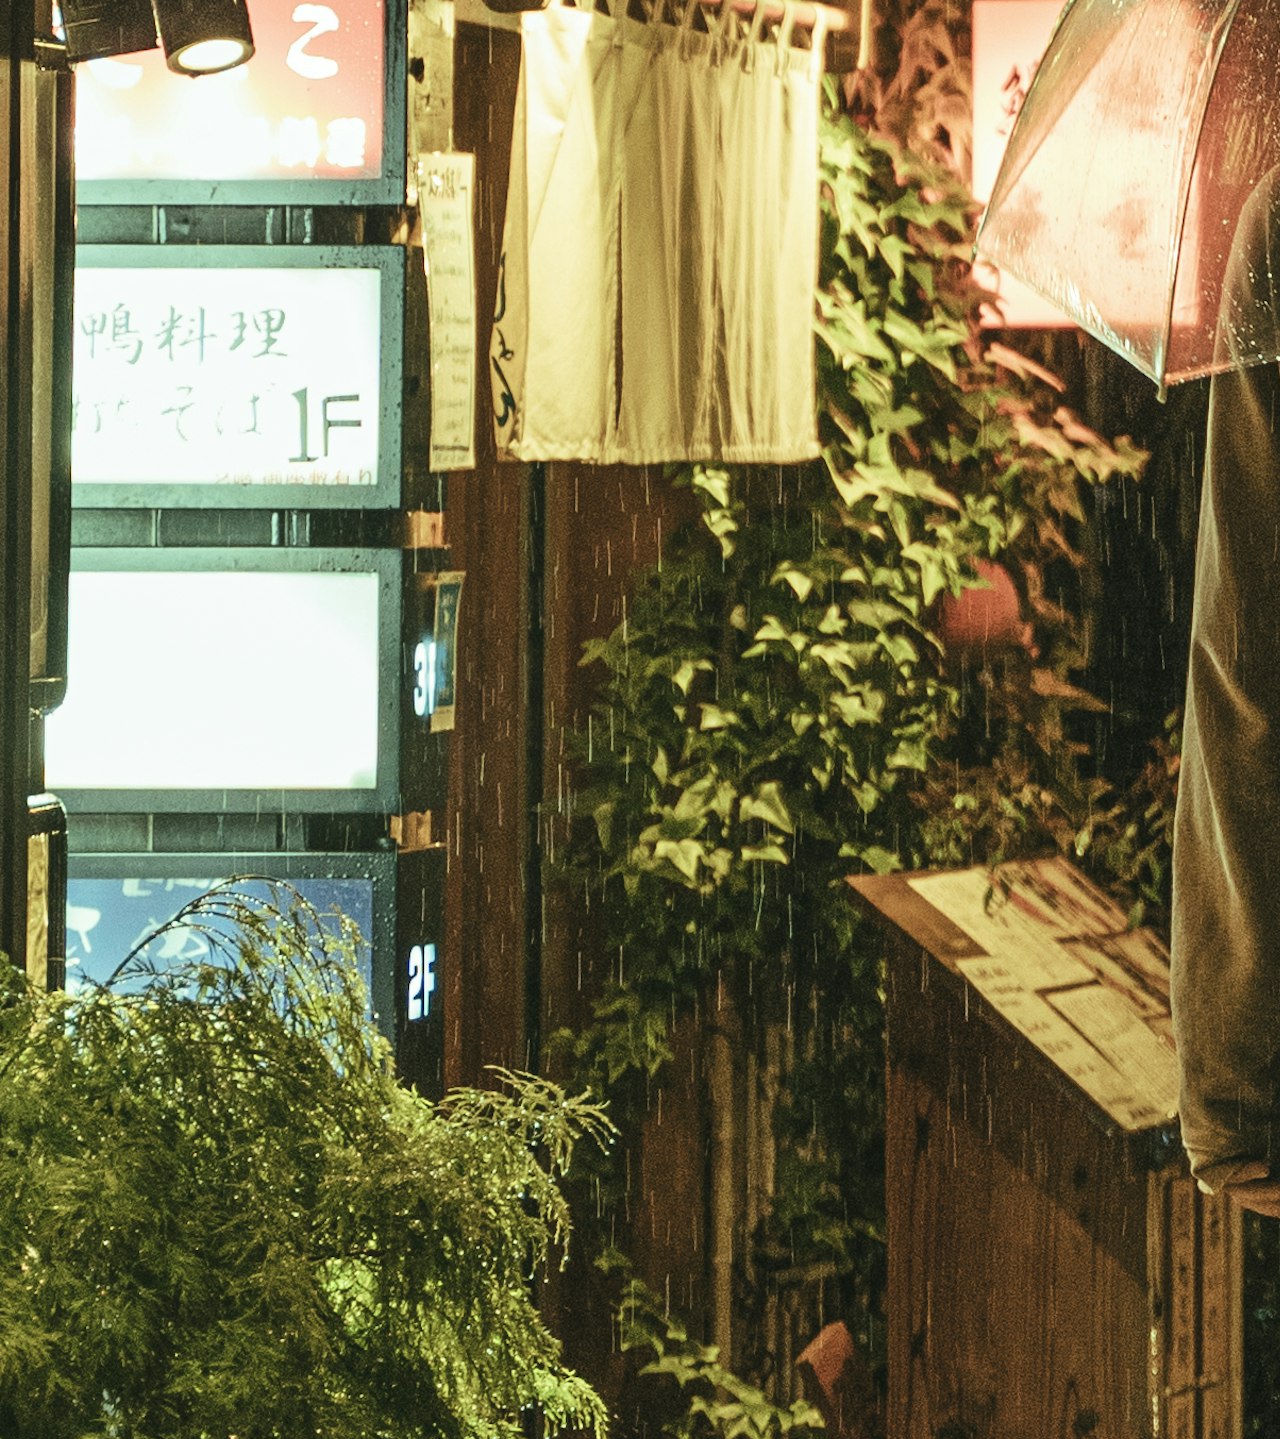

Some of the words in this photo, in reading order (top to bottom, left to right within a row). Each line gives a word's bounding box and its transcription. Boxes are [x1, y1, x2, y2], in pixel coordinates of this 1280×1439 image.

[80, 302, 289, 366] 鴨料理
[288, 386, 363, 463] 1F
[407, 942, 438, 1021] 2F
